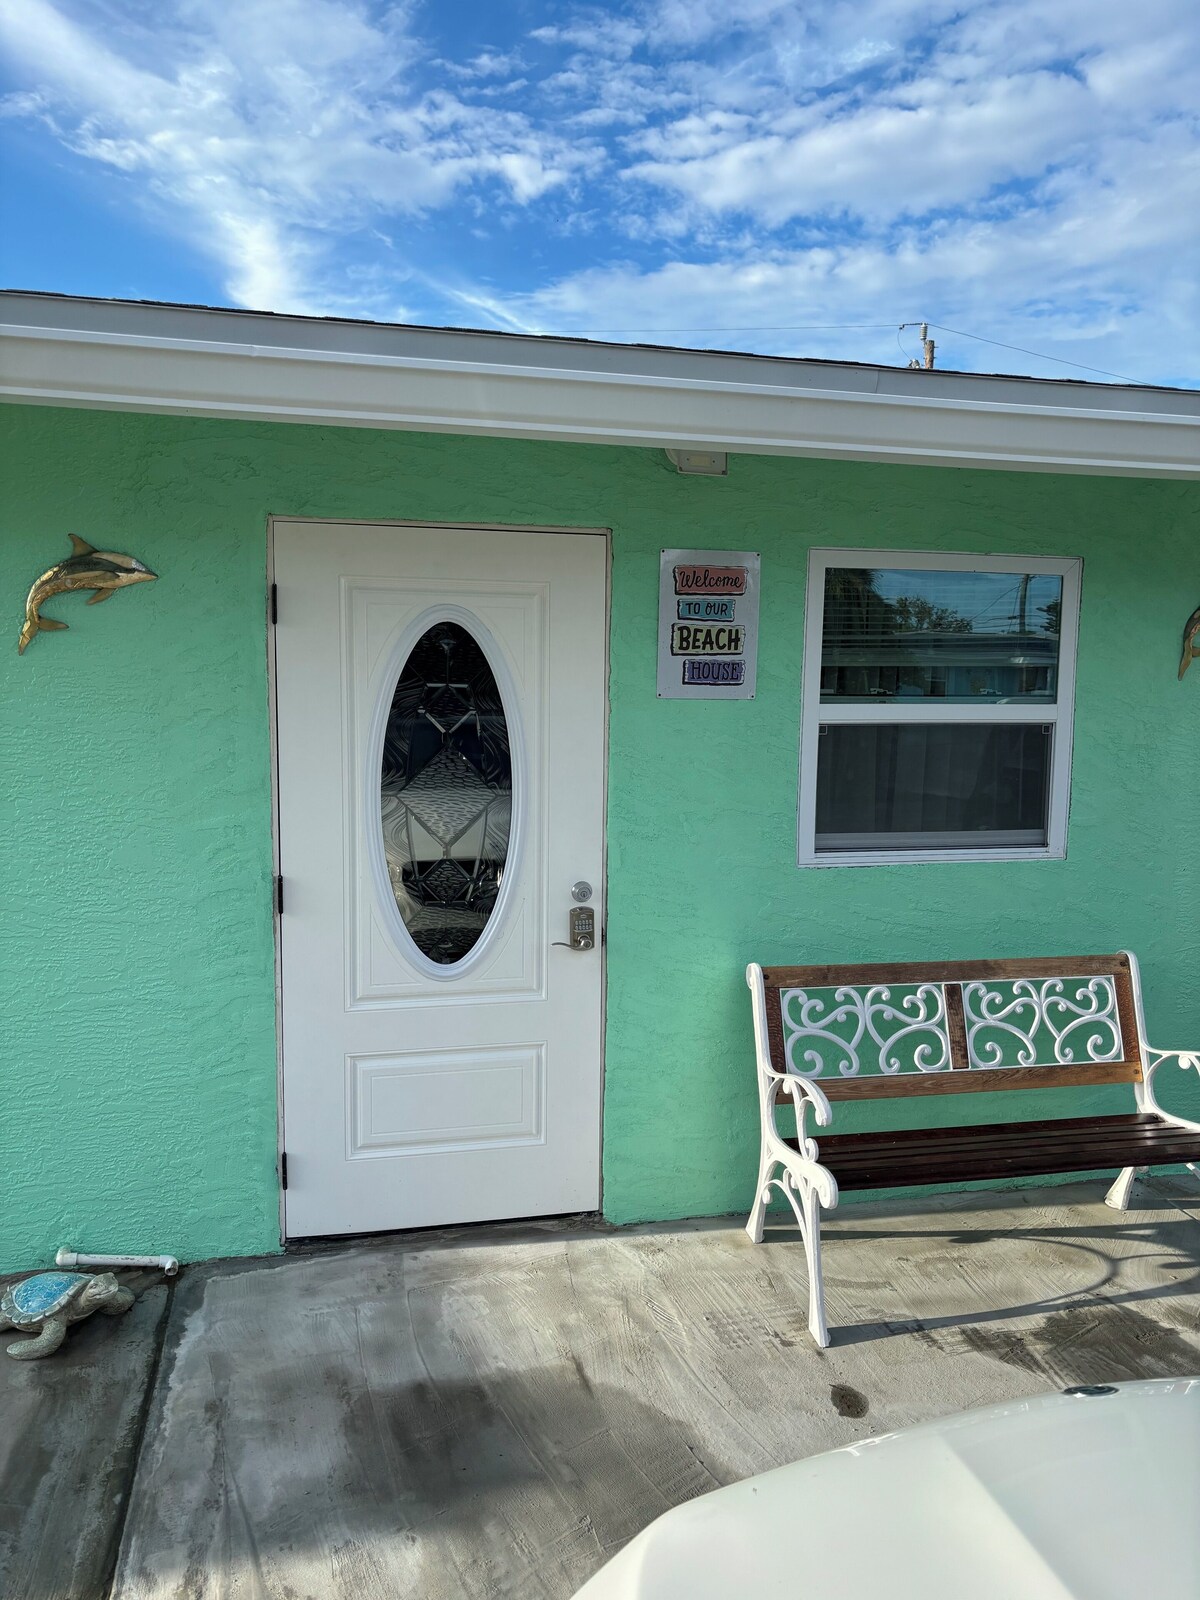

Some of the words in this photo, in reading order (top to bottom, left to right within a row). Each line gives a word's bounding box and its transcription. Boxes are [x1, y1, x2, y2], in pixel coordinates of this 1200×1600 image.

[680, 569, 743, 588] Welcome
[686, 602, 700, 615] TO
[705, 602, 728, 616] OUR
[677, 625, 741, 651] BEACH
[690, 661, 740, 681] HOUSE
